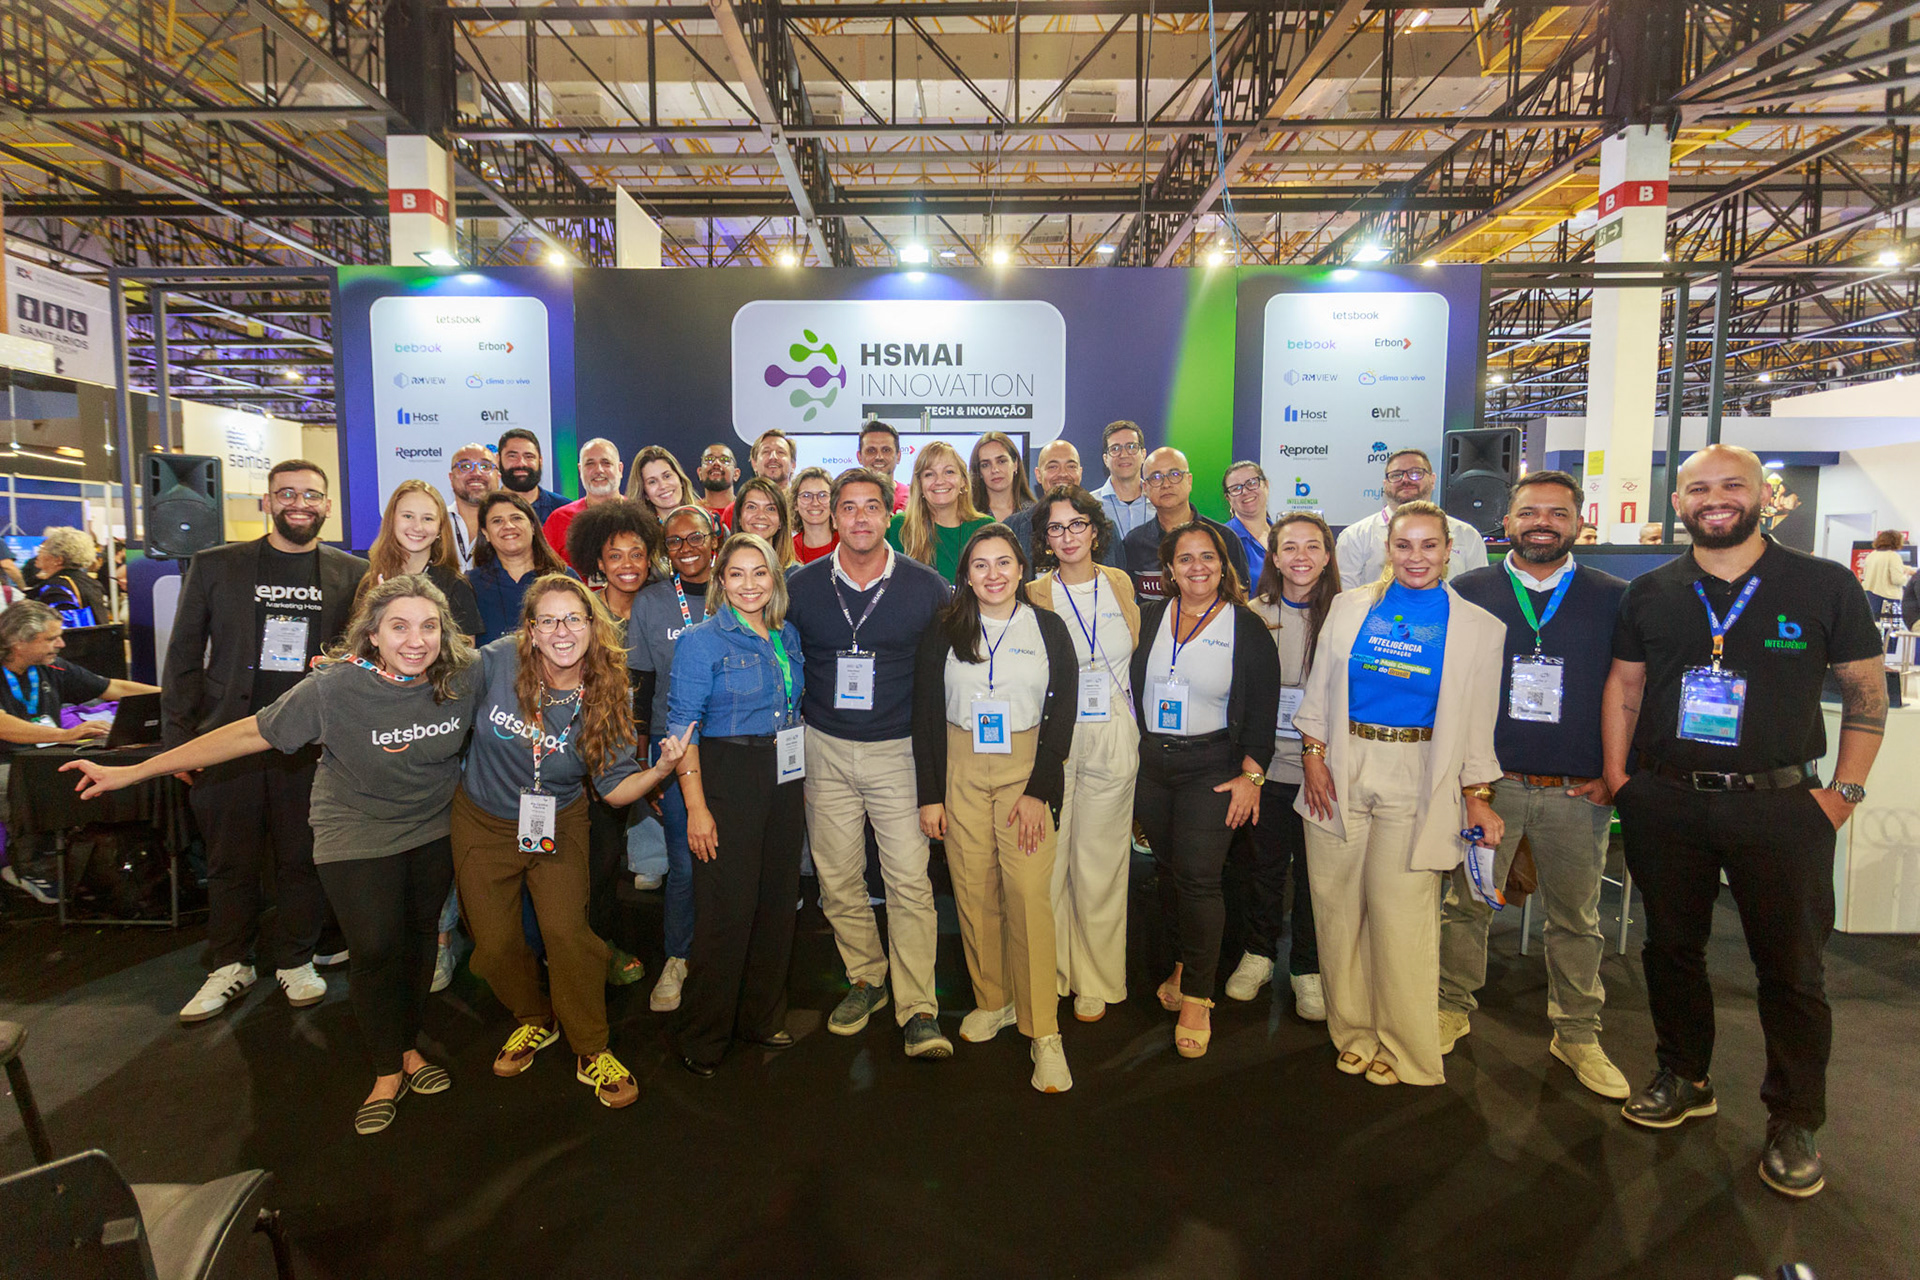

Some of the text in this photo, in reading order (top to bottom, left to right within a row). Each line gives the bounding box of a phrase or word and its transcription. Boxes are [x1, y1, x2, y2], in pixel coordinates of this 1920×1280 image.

[1639, 186, 1654, 202] B
[402, 193, 416, 210] B
[1605, 194, 1615, 212] B
[435, 199, 444, 217] B
[436, 315, 481, 324] letsbook
[1332, 311, 1379, 320] letsbook
[395, 343, 442, 353] bebook
[478, 342, 506, 351] Erbon
[1287, 339, 1336, 350] bebook
[1374, 338, 1403, 348] Erbon
[860, 343, 963, 366] HSMAI
[1379, 374, 1398, 382] clima
[860, 373, 1034, 398] INNOVATION
[412, 412, 439, 422] Host
[481, 409, 509, 421] evnt
[925, 404, 1026, 418] TECH & INOVAÇÃO
[1300, 409, 1328, 419] Host
[1371, 406, 1400, 418] evnt
[395, 447, 442, 460] Reprotel
[1280, 444, 1328, 457] Reprotel
[229, 454, 270, 470] samba
[266, 601, 303, 611] Marketing
[1203, 638, 1230, 648] myHotel
[1368, 636, 1422, 654] INTELIGÊNCIA
[1008, 648, 1036, 656] myHotel
[372, 716, 461, 746] letsbook
